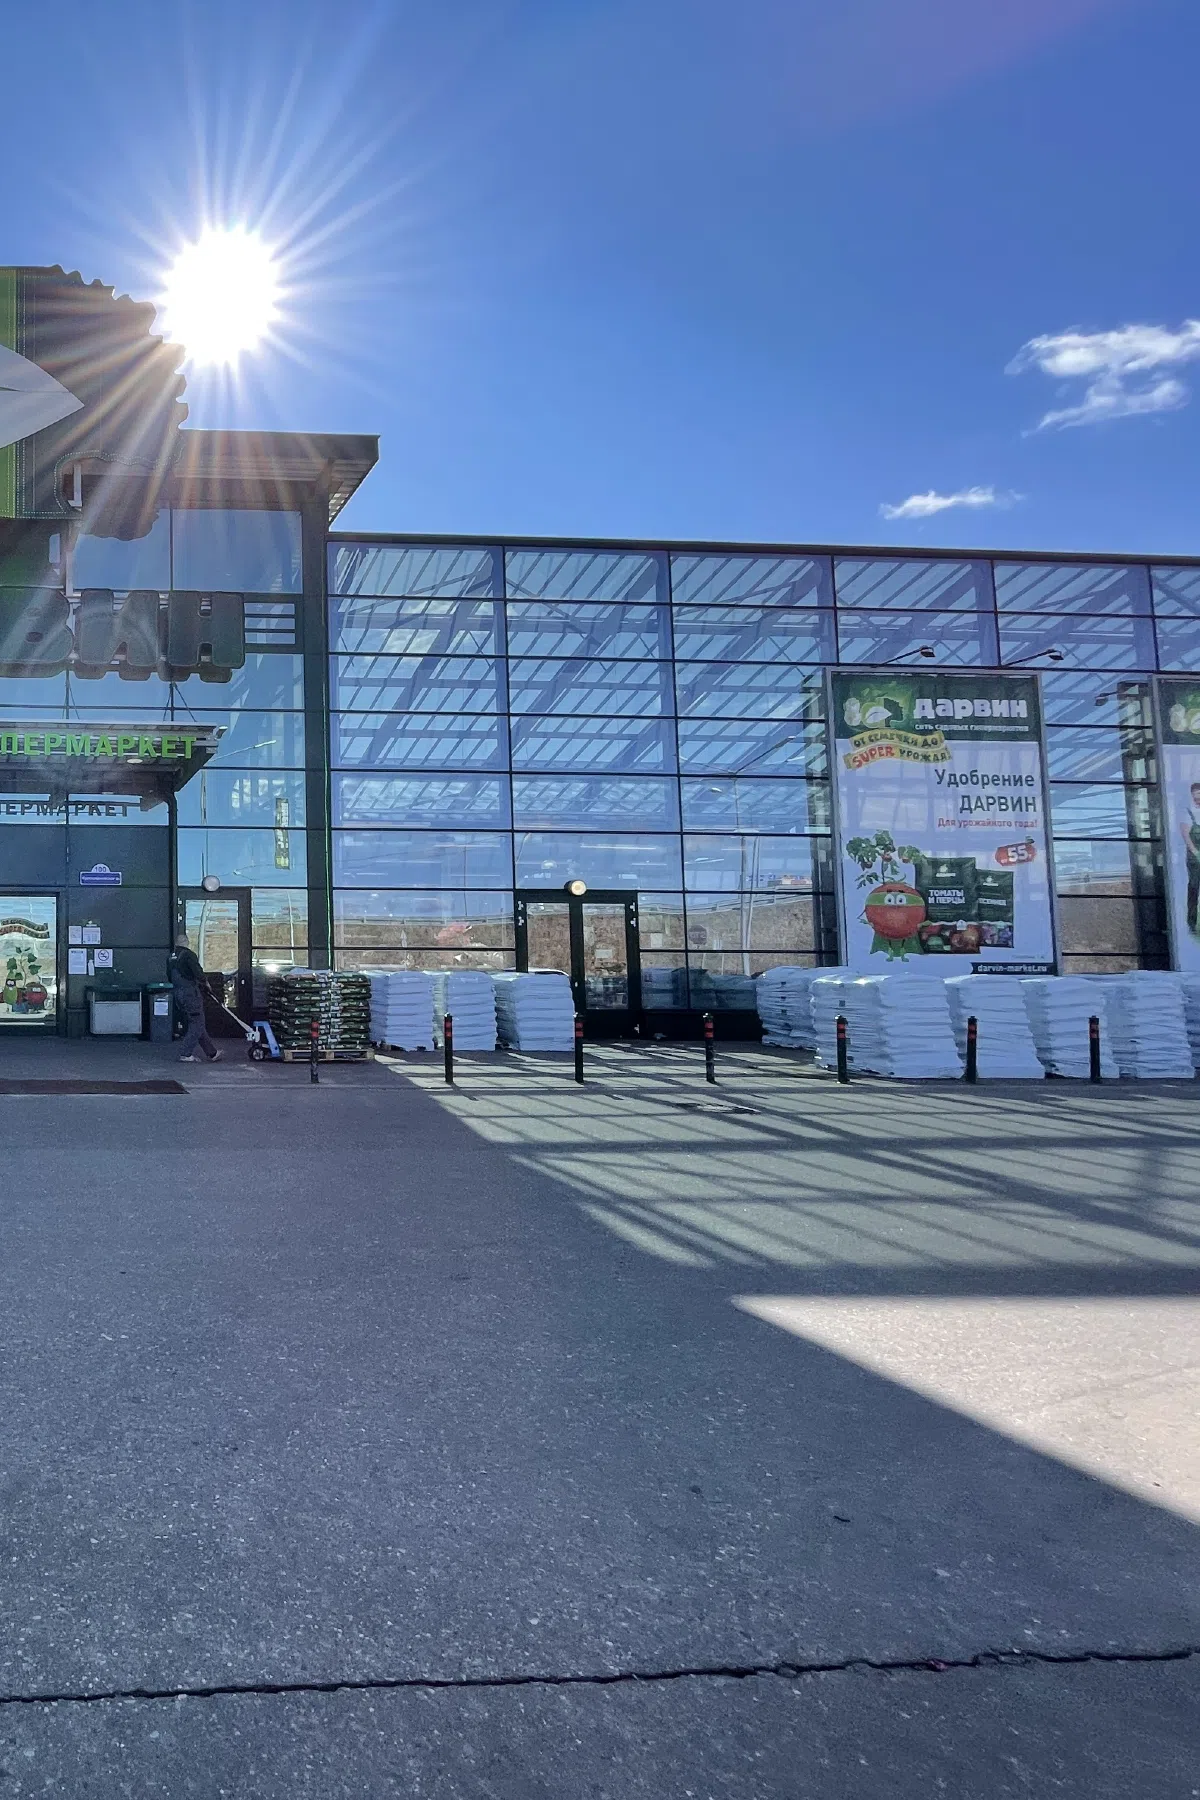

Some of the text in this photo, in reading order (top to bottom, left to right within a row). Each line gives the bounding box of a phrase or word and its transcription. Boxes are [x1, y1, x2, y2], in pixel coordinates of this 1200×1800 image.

[913, 698, 1028, 720] дарвин
[852, 746, 896, 768] SUPER
[934, 769, 1035, 789] Удобрение
[959, 795, 1037, 814] ДАРВИН
[937, 818, 957, 828] Для
